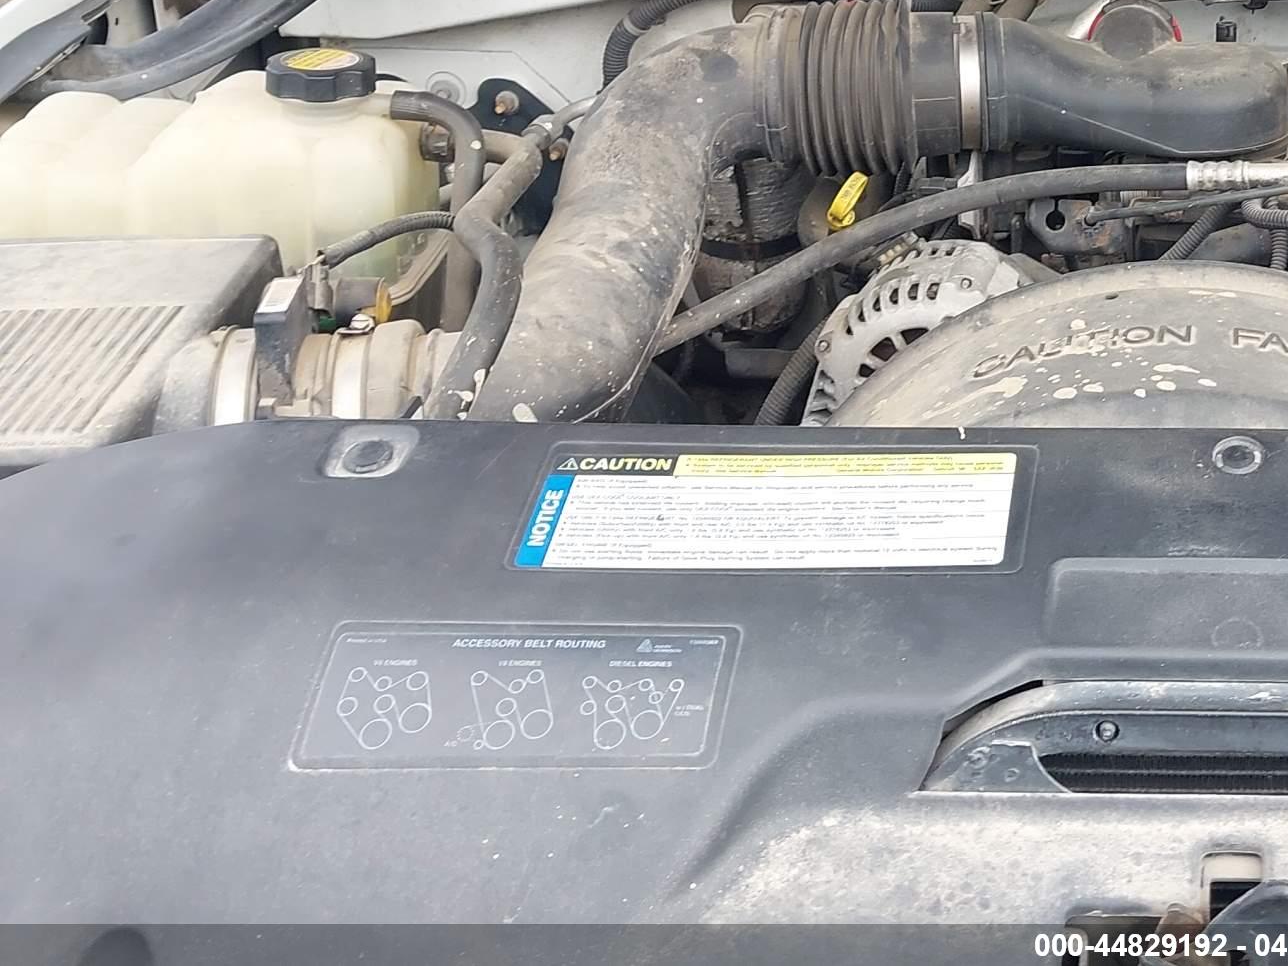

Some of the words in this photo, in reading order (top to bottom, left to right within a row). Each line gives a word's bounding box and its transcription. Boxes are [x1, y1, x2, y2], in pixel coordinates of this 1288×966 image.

[973, 325, 1192, 378] CAUTION
[579, 458, 673, 470] CAUTION
[526, 489, 564, 547] NOTICE
[452, 639, 522, 648] ACCESSORY
[524, 639, 554, 648] BELT
[555, 640, 607, 648] ROUTING
